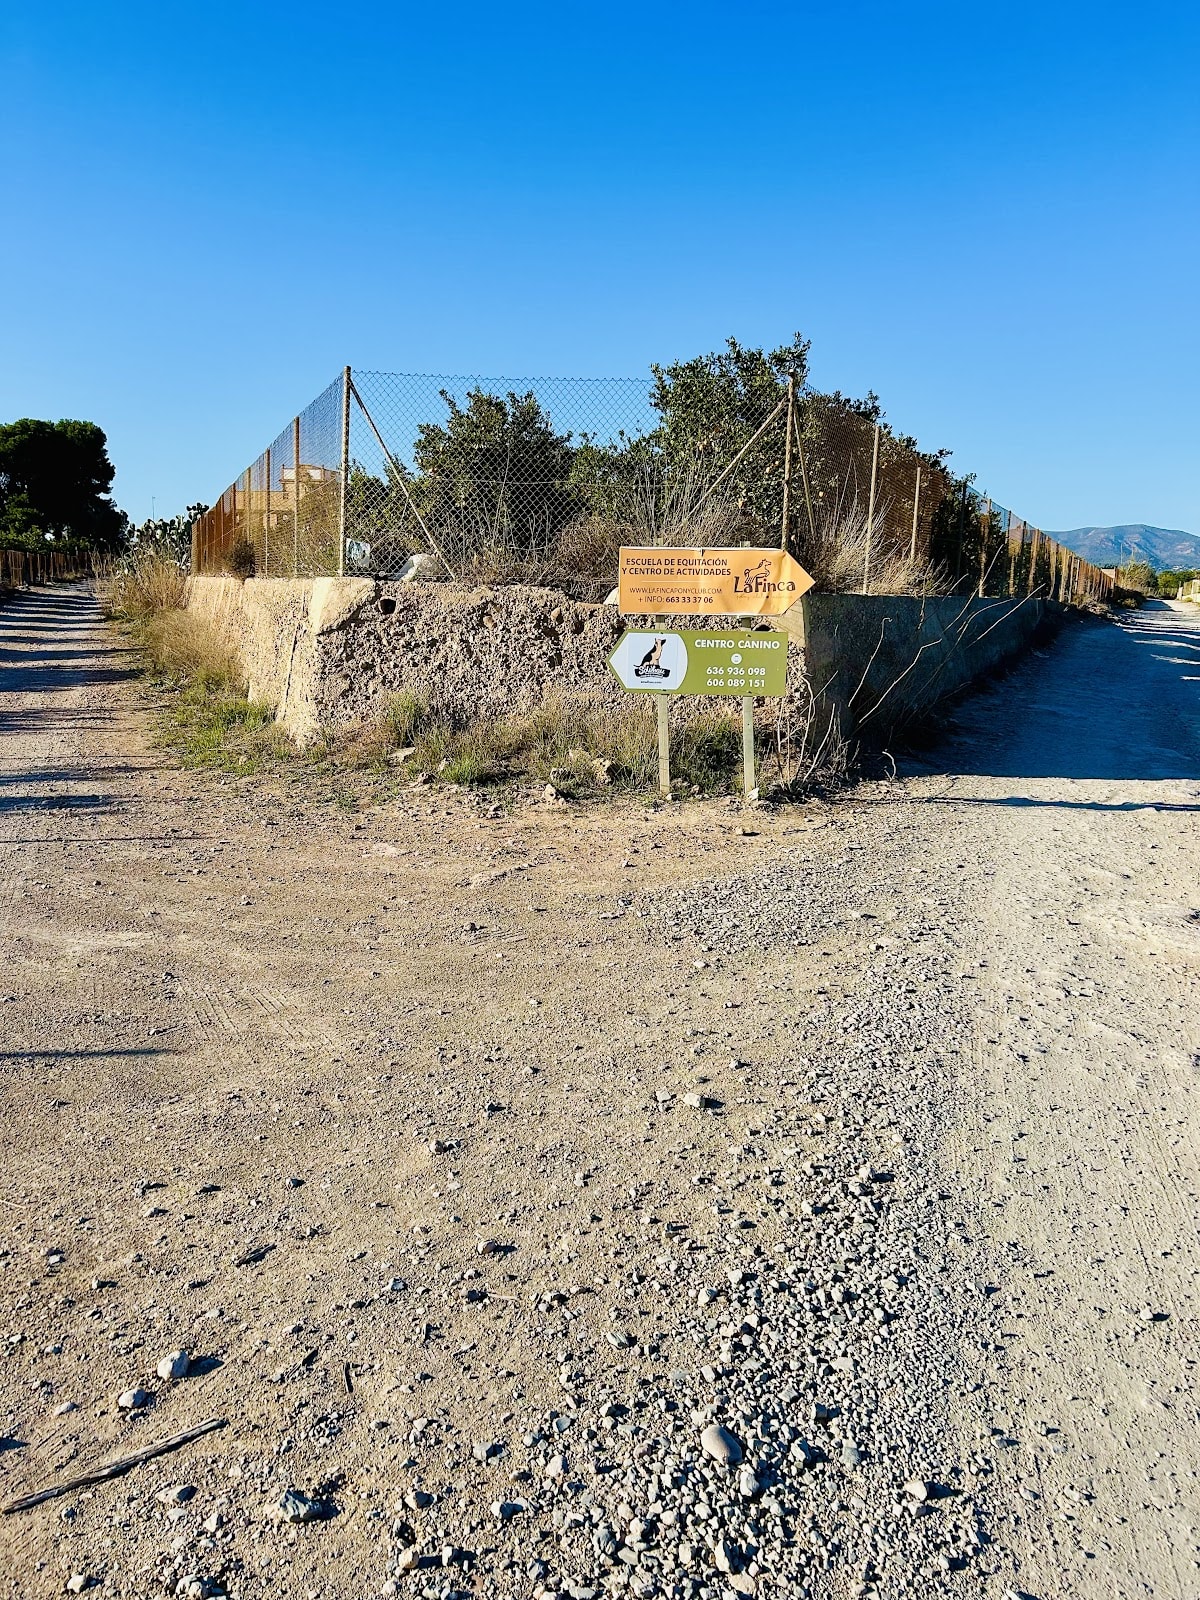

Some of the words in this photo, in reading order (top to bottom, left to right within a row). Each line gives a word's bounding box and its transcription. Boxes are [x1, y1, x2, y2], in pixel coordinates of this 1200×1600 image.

[626, 558, 662, 566] ESCUELA
[664, 558, 675, 566] DE
[677, 557, 728, 566] EQUITACIÓN
[622, 567, 627, 575] Y
[629, 567, 662, 575] CENTRO
[676, 568, 731, 576] ACTIVIDADES
[629, 587, 722, 595] WWW.LAFINCAPONYCLUB.COM
[665, 596, 680, 604] 663
[681, 596, 691, 604] 33
[694, 639, 735, 649] CENTRO
[737, 639, 781, 650] CANINO
[706, 666, 725, 676] 636
[726, 666, 745, 676] 936
[747, 667, 766, 676] 098
[706, 678, 725, 687] 606
[727, 678, 745, 687] 089
[748, 679, 765, 688] 151
